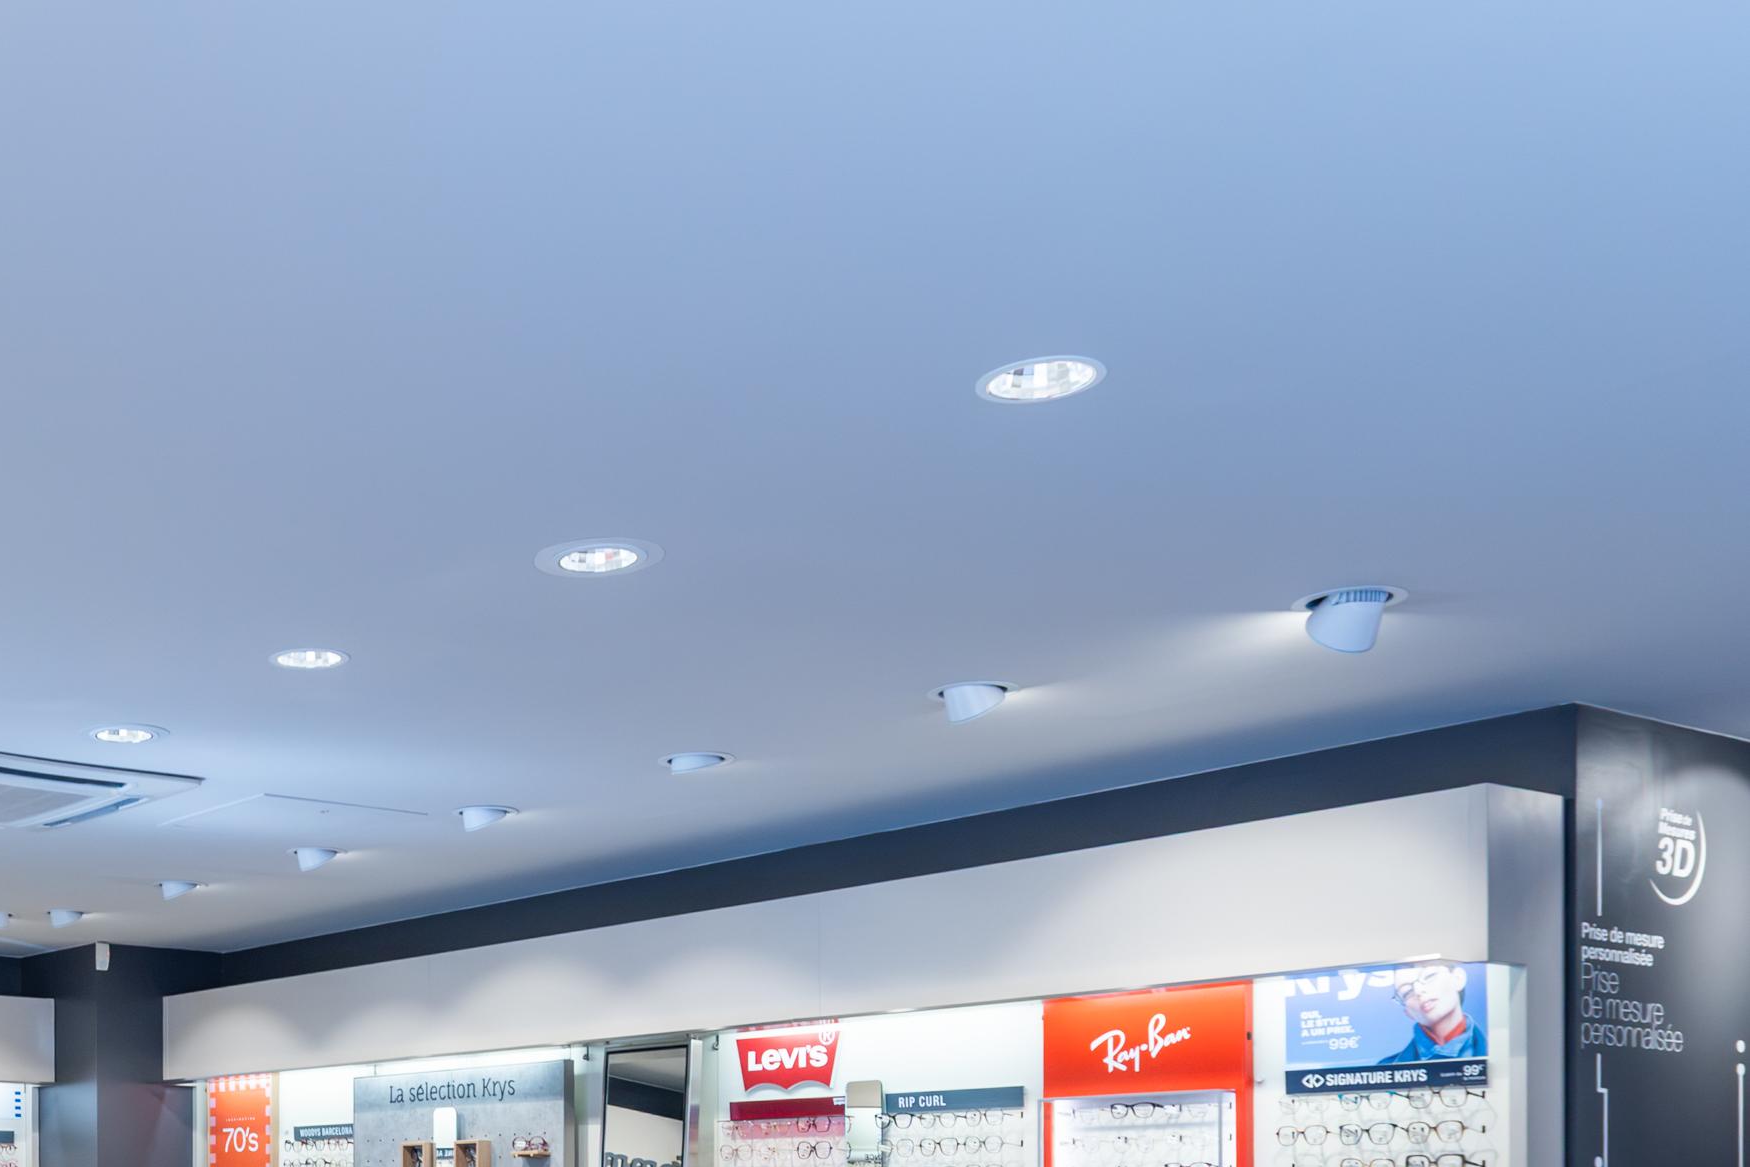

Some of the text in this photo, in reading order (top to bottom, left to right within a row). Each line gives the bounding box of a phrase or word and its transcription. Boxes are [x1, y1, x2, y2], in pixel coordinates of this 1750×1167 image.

[1656, 837, 1696, 878] 3D
[1581, 922, 1665, 949] Prise de mesure
[1581, 945, 1654, 967] personnalisée
[1581, 961, 1619, 994] Prise
[1581, 990, 1665, 1025] de mesure
[1316, 1016, 1349, 1027] STYLE
[1581, 1022, 1683, 1053] personnalisée
[1326, 1070, 1392, 1087] SIGNATURE
[1394, 1069, 1428, 1082] KRYS
[389, 1078, 516, 1104] La sélection Krys
[898, 1094, 946, 1108] RIP CURL
[222, 1127, 259, 1152] 70's
[300, 1126, 353, 1138] WOODYS BARCELONA
